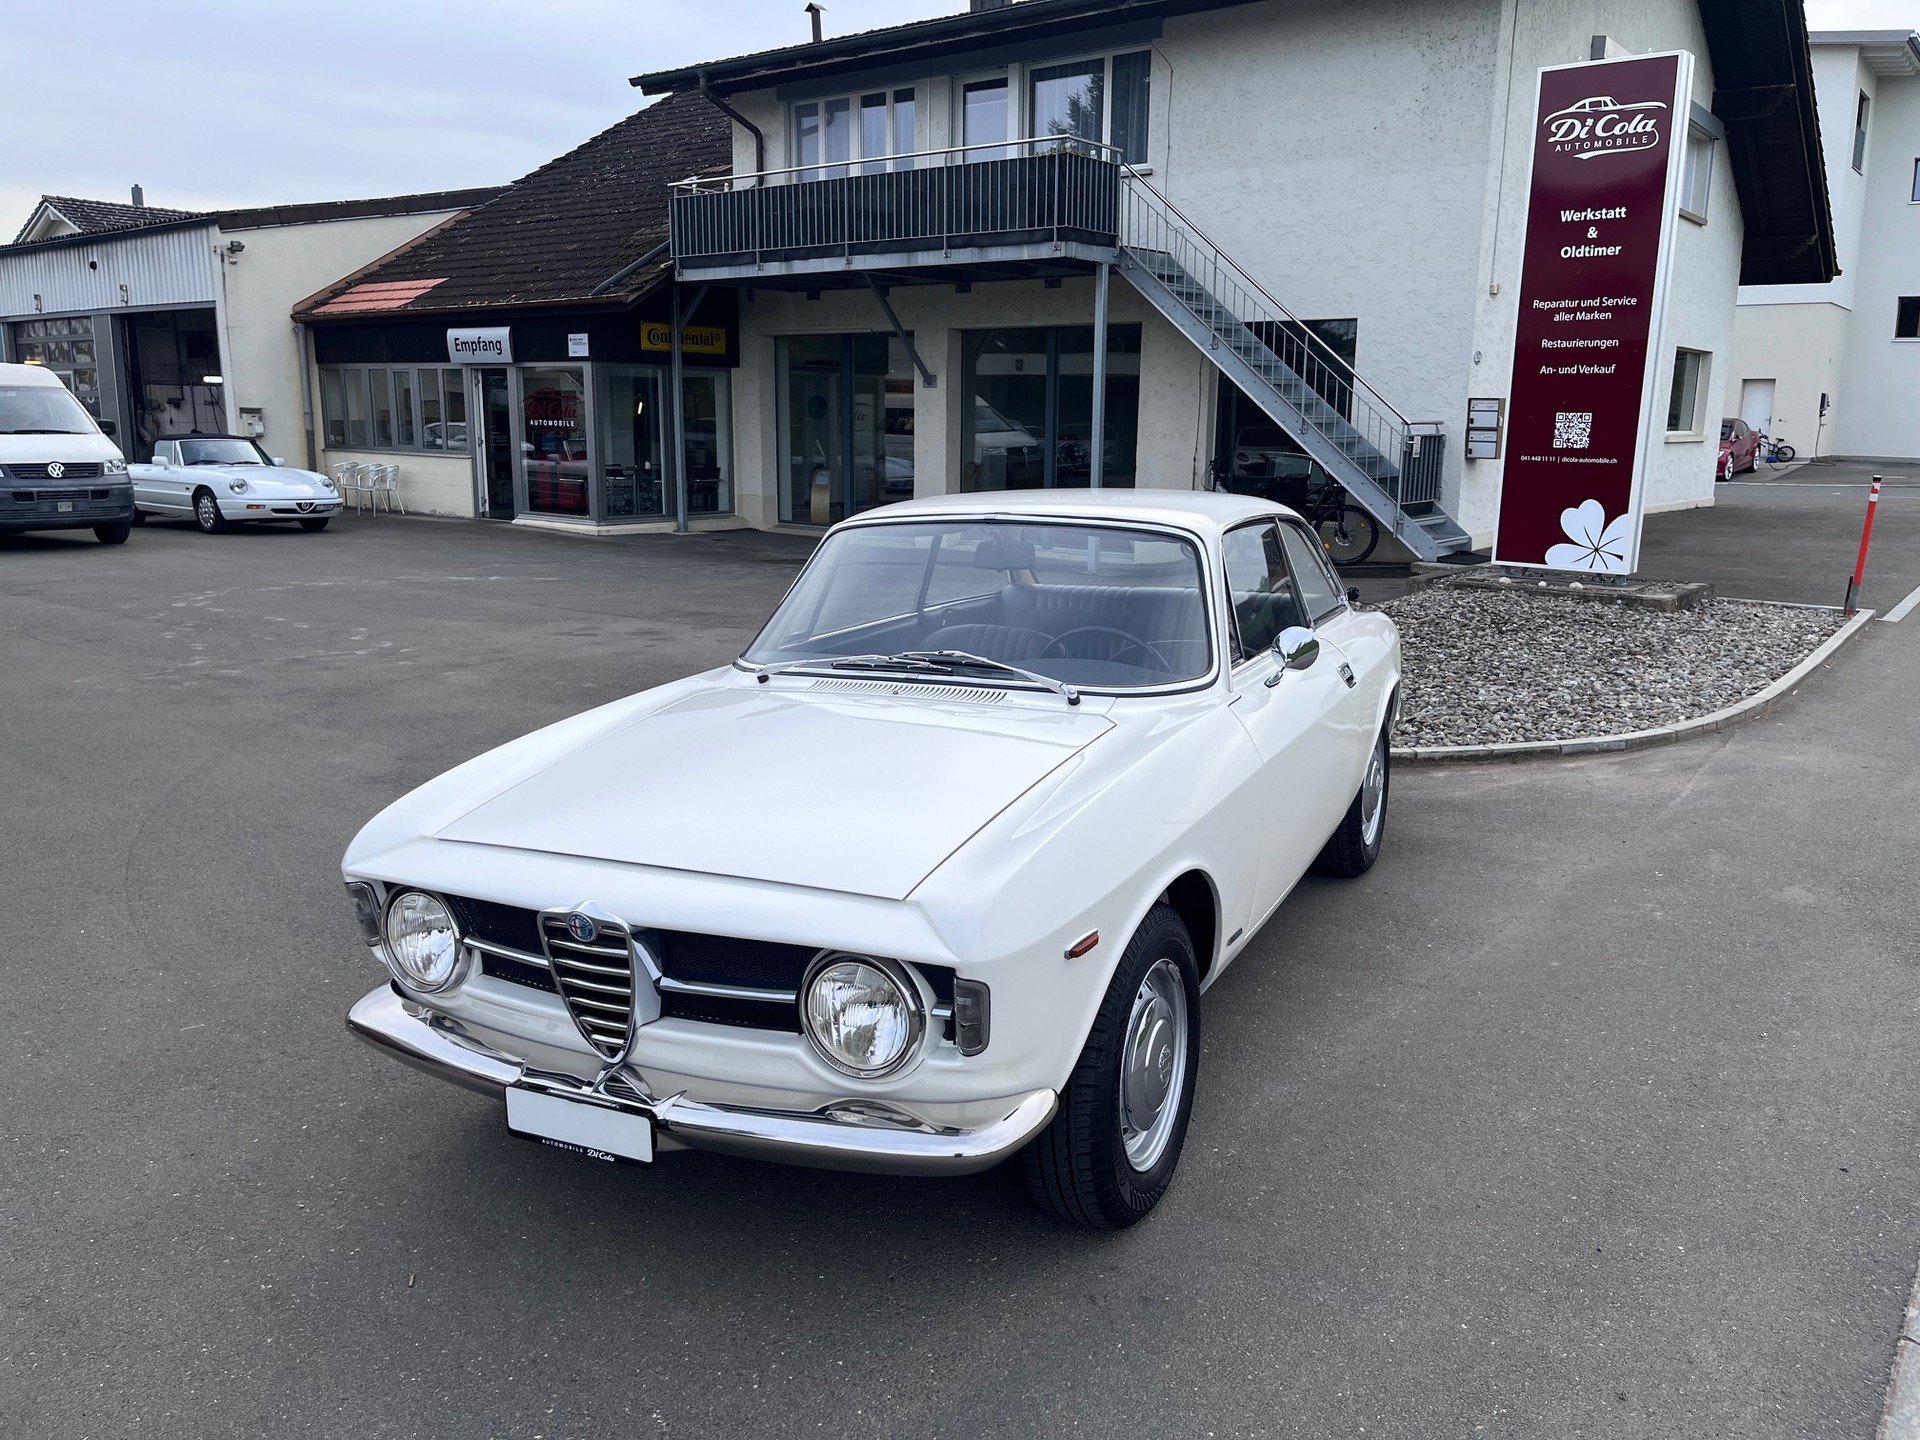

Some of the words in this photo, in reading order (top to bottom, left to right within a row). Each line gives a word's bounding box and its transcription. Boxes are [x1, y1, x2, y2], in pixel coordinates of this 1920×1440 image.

[1548, 117, 1593, 142] Di
[1595, 114, 1657, 137] Cola
[1555, 135, 1648, 152] AUTOMOBILE
[1560, 206, 1627, 222] Werkstatt
[1586, 226, 1598, 239] &
[1560, 244, 1622, 258] Oldtimer
[1532, 299, 1580, 310] Reparatur
[1580, 297, 1601, 307] und
[1602, 296, 1638, 306] Service
[1553, 311, 1574, 321] aller
[1575, 310, 1612, 321] Marken
[454, 336, 502, 356] Empfang
[1541, 338, 1619, 349] Restaurierungen
[1540, 365, 1556, 374] An-
[1558, 365, 1577, 374] und
[1578, 364, 1616, 374] Verkauf
[530, 419, 575, 427] AUTOMOBILE
[542, 1139, 583, 1153] AUTOMOBILE
